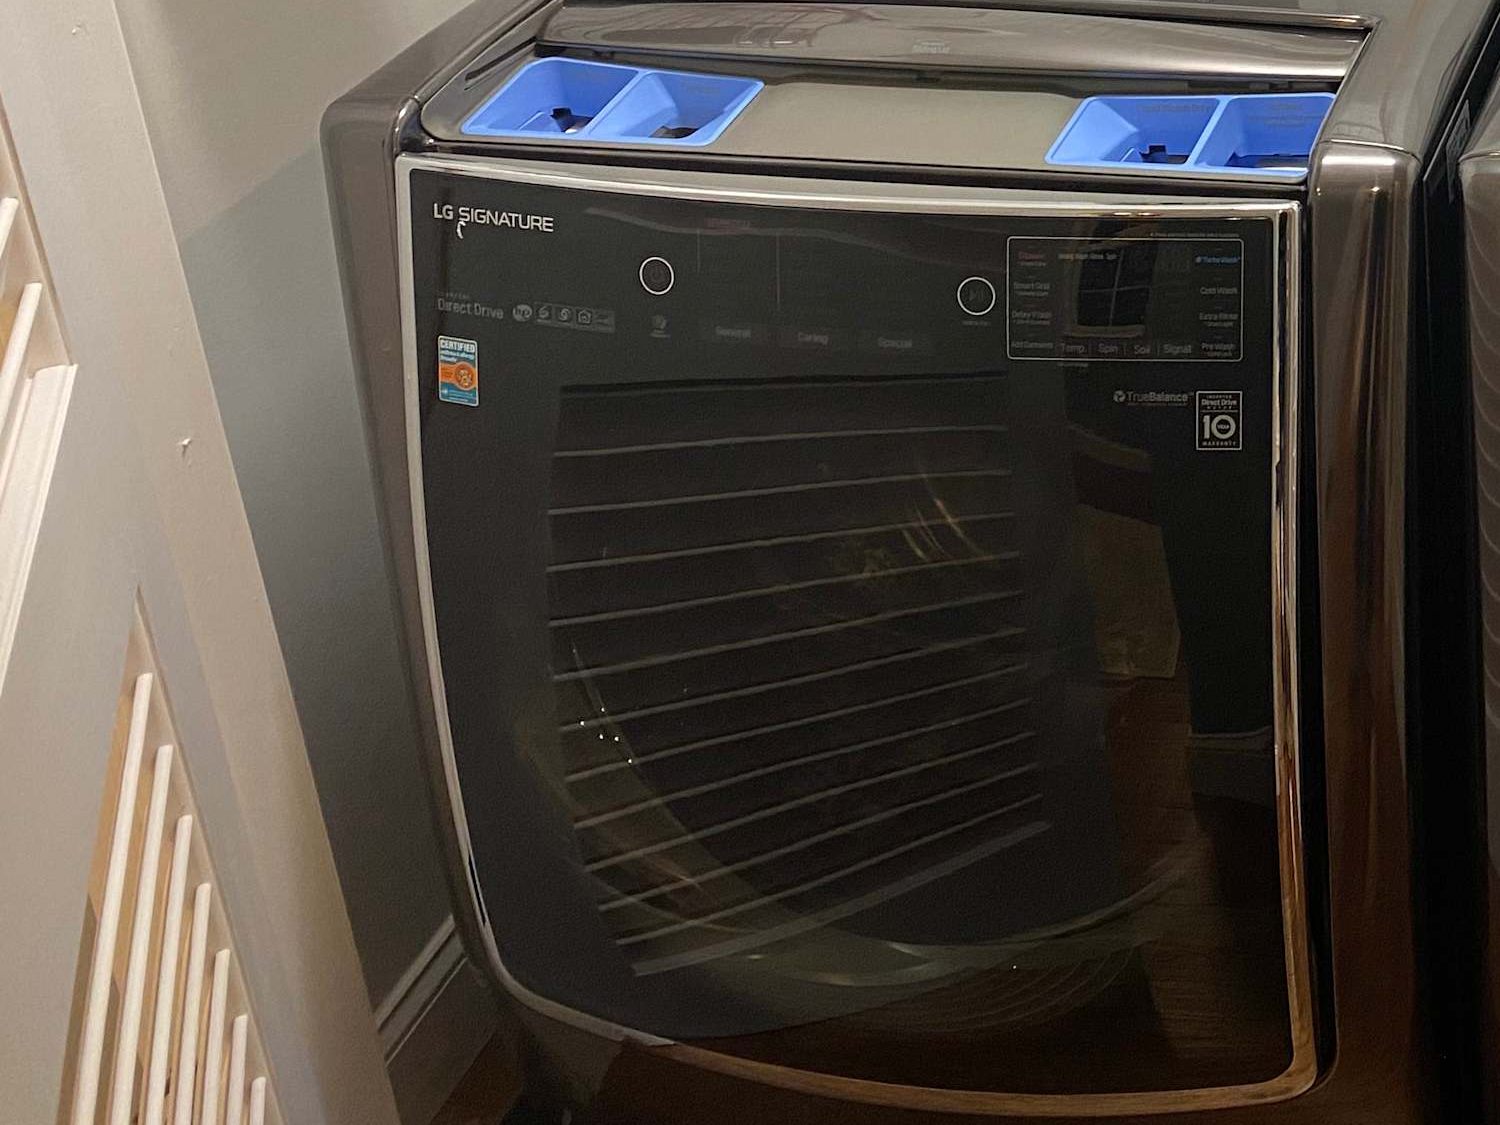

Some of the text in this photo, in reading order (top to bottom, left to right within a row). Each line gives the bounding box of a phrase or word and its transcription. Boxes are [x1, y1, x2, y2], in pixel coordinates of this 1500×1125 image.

[433, 203, 554, 232] LG SIGNATURE
[437, 298, 504, 319] Direct Drive
[440, 339, 475, 353] CERTIFIED
[1203, 414, 1236, 439] 10
